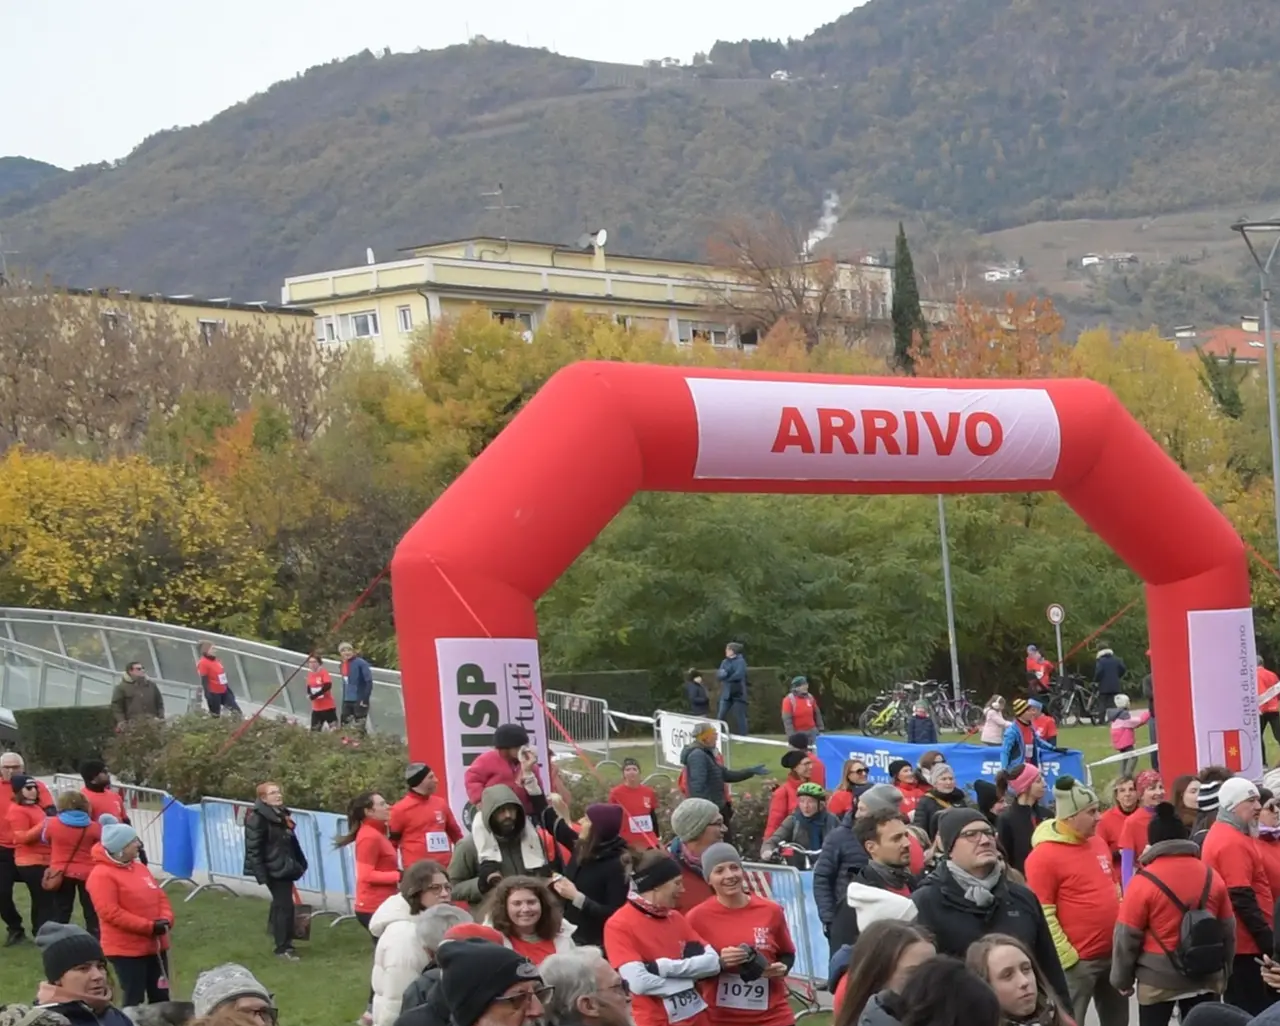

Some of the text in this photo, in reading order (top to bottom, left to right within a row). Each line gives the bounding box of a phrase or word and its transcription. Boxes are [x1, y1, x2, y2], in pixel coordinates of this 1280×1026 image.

[771, 407, 1003, 457] ARRIVO
[1239, 624, 1249, 678] Bolzano
[722, 983, 765, 998] 1079
